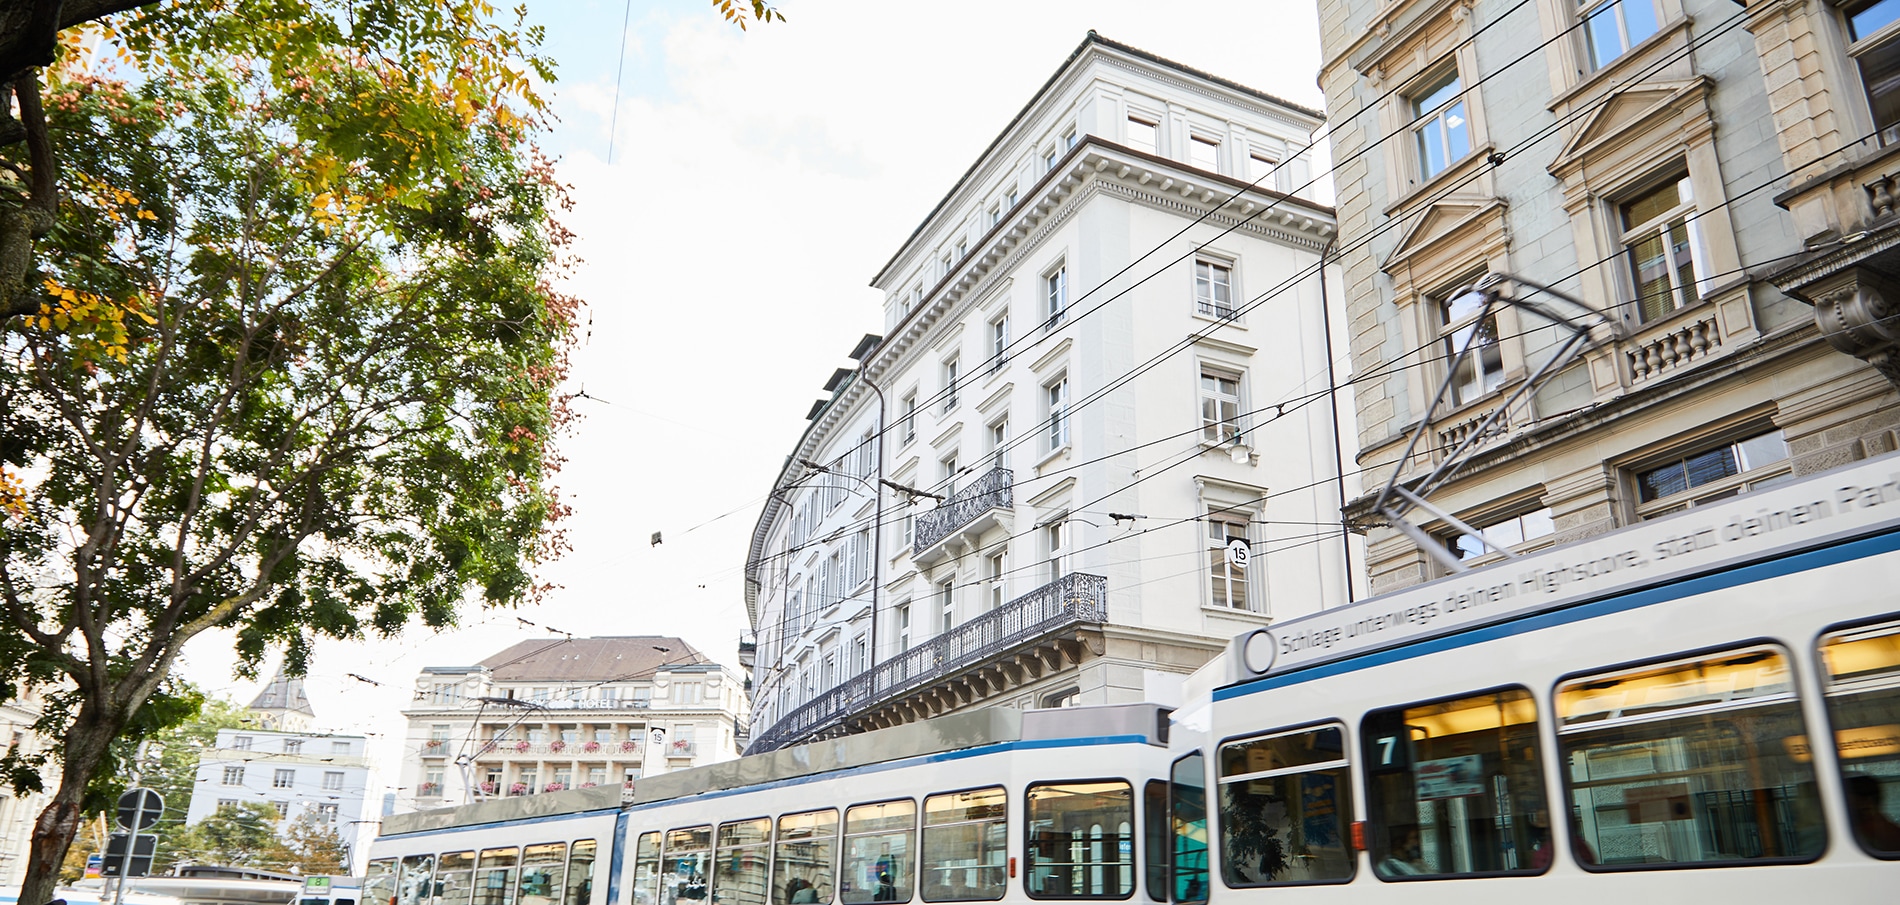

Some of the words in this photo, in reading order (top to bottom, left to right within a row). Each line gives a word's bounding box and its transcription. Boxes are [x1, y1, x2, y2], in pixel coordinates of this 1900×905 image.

[1233, 547, 1246, 560] 15
[1279, 626, 1343, 655] Schlage
[1345, 601, 1440, 638] unterwegs
[1442, 579, 1516, 614] deinen
[1518, 549, 1649, 594] Highscore,
[1653, 526, 1718, 560] statt
[1721, 499, 1833, 542] deinen
[579, 699, 613, 709] HOTEL
[654, 733, 662, 742] 15
[1376, 736, 1396, 765] 7
[315, 878, 322, 886] 8
